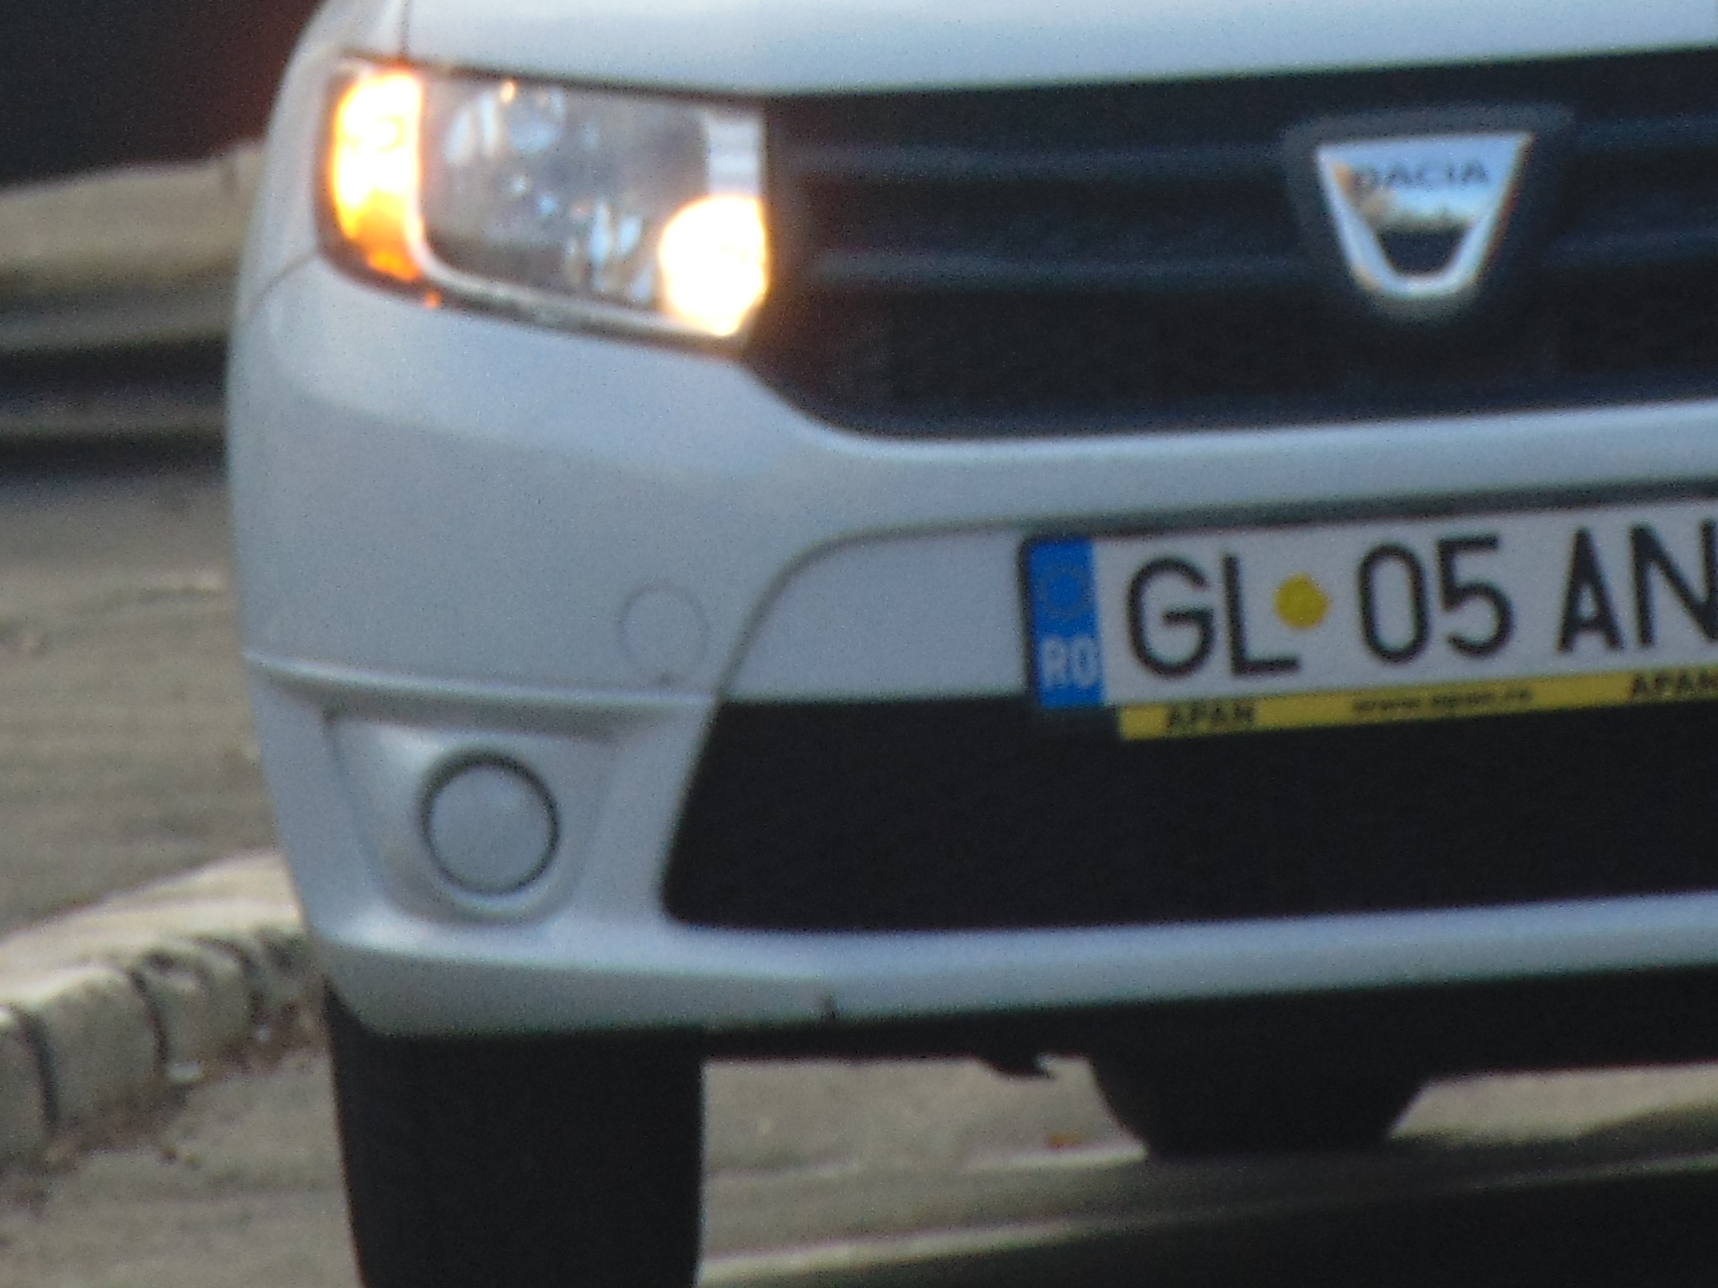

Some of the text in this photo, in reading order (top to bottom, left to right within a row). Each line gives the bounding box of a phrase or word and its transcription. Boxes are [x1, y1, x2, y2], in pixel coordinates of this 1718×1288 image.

[1349, 159, 1489, 188] DACIA
[1127, 551, 1301, 679] GL
[1357, 534, 1515, 665] 05
[1040, 636, 1099, 688] RO
[1166, 699, 1256, 731] APAN
